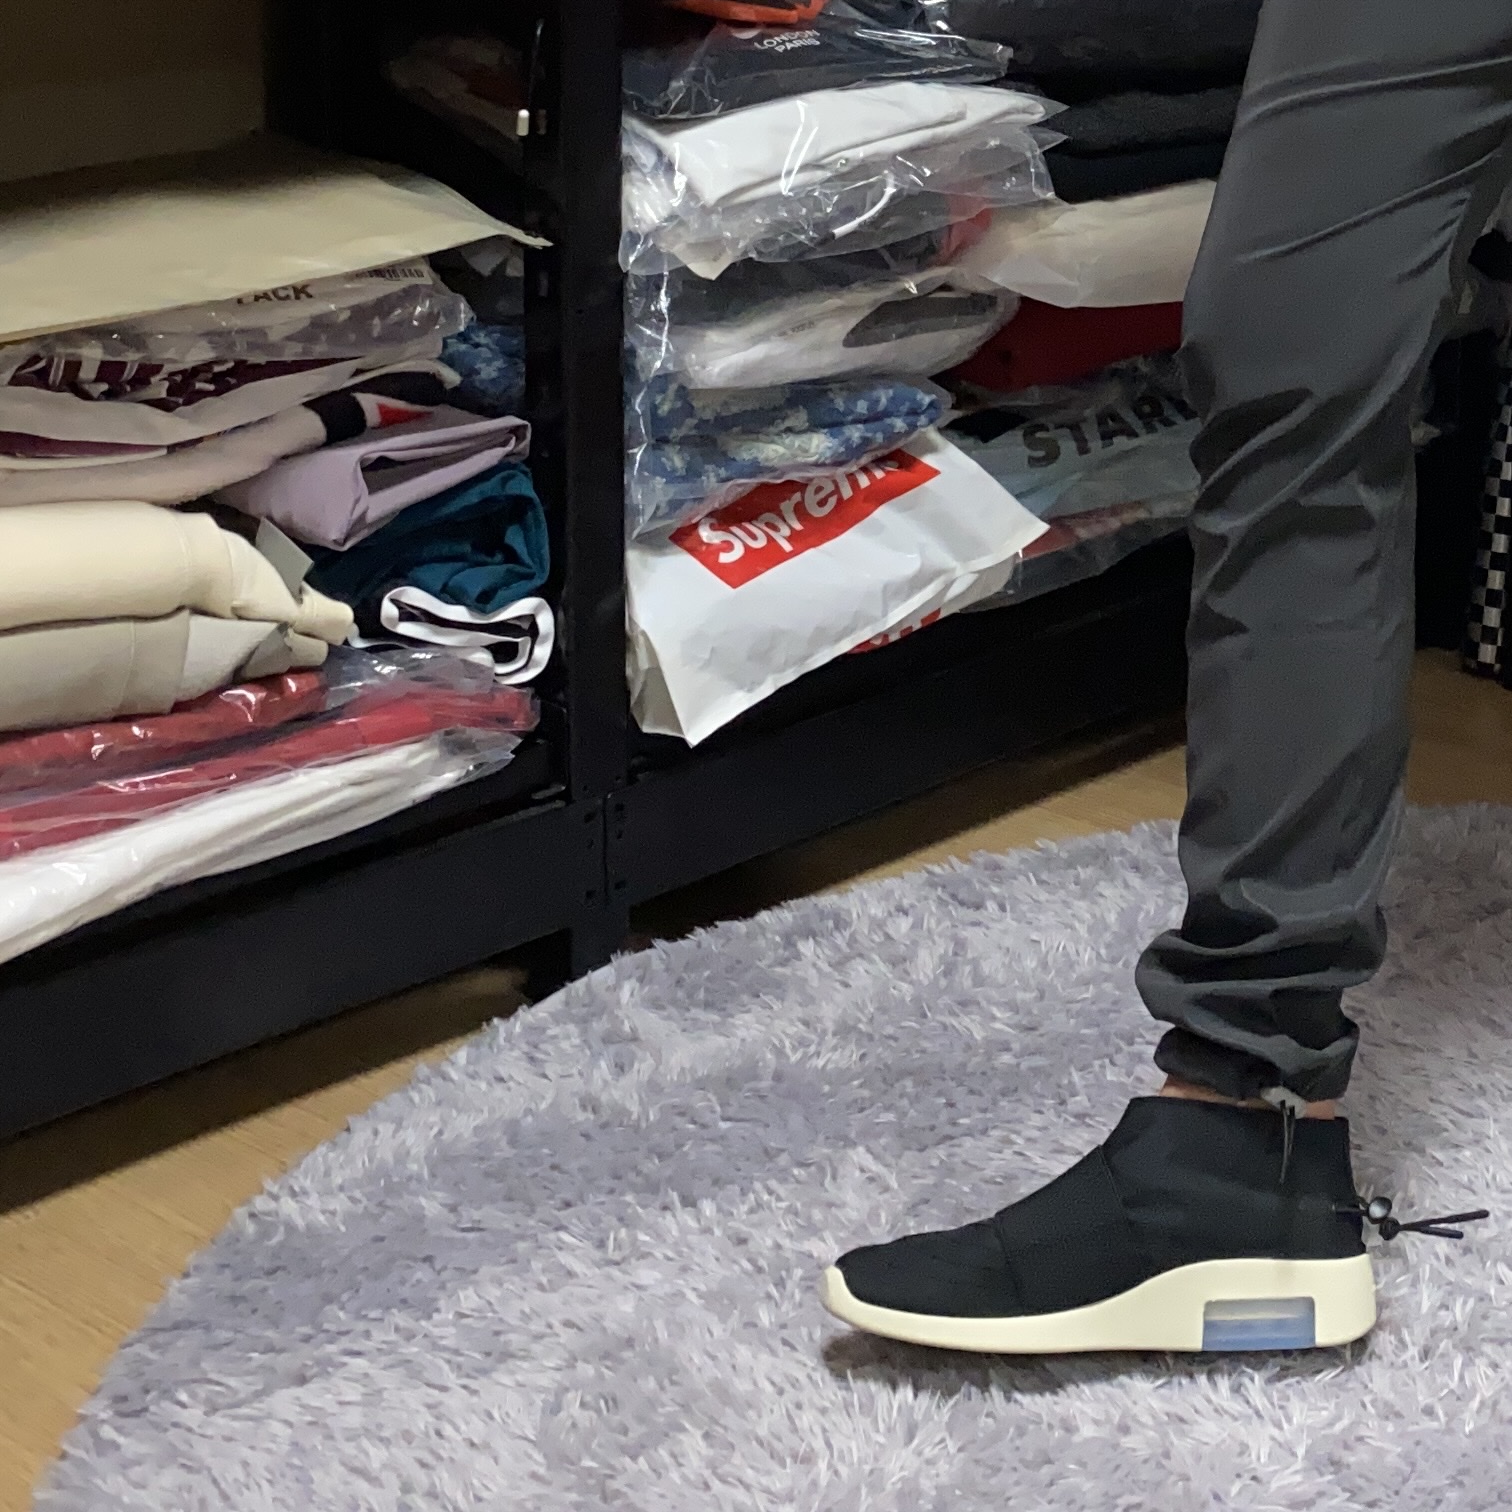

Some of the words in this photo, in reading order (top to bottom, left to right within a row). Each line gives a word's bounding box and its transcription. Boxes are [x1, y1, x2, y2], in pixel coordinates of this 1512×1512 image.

[754, 29, 820, 50] LONDON
[774, 38, 820, 52] PARIS
[699, 450, 900, 565] Suprem
